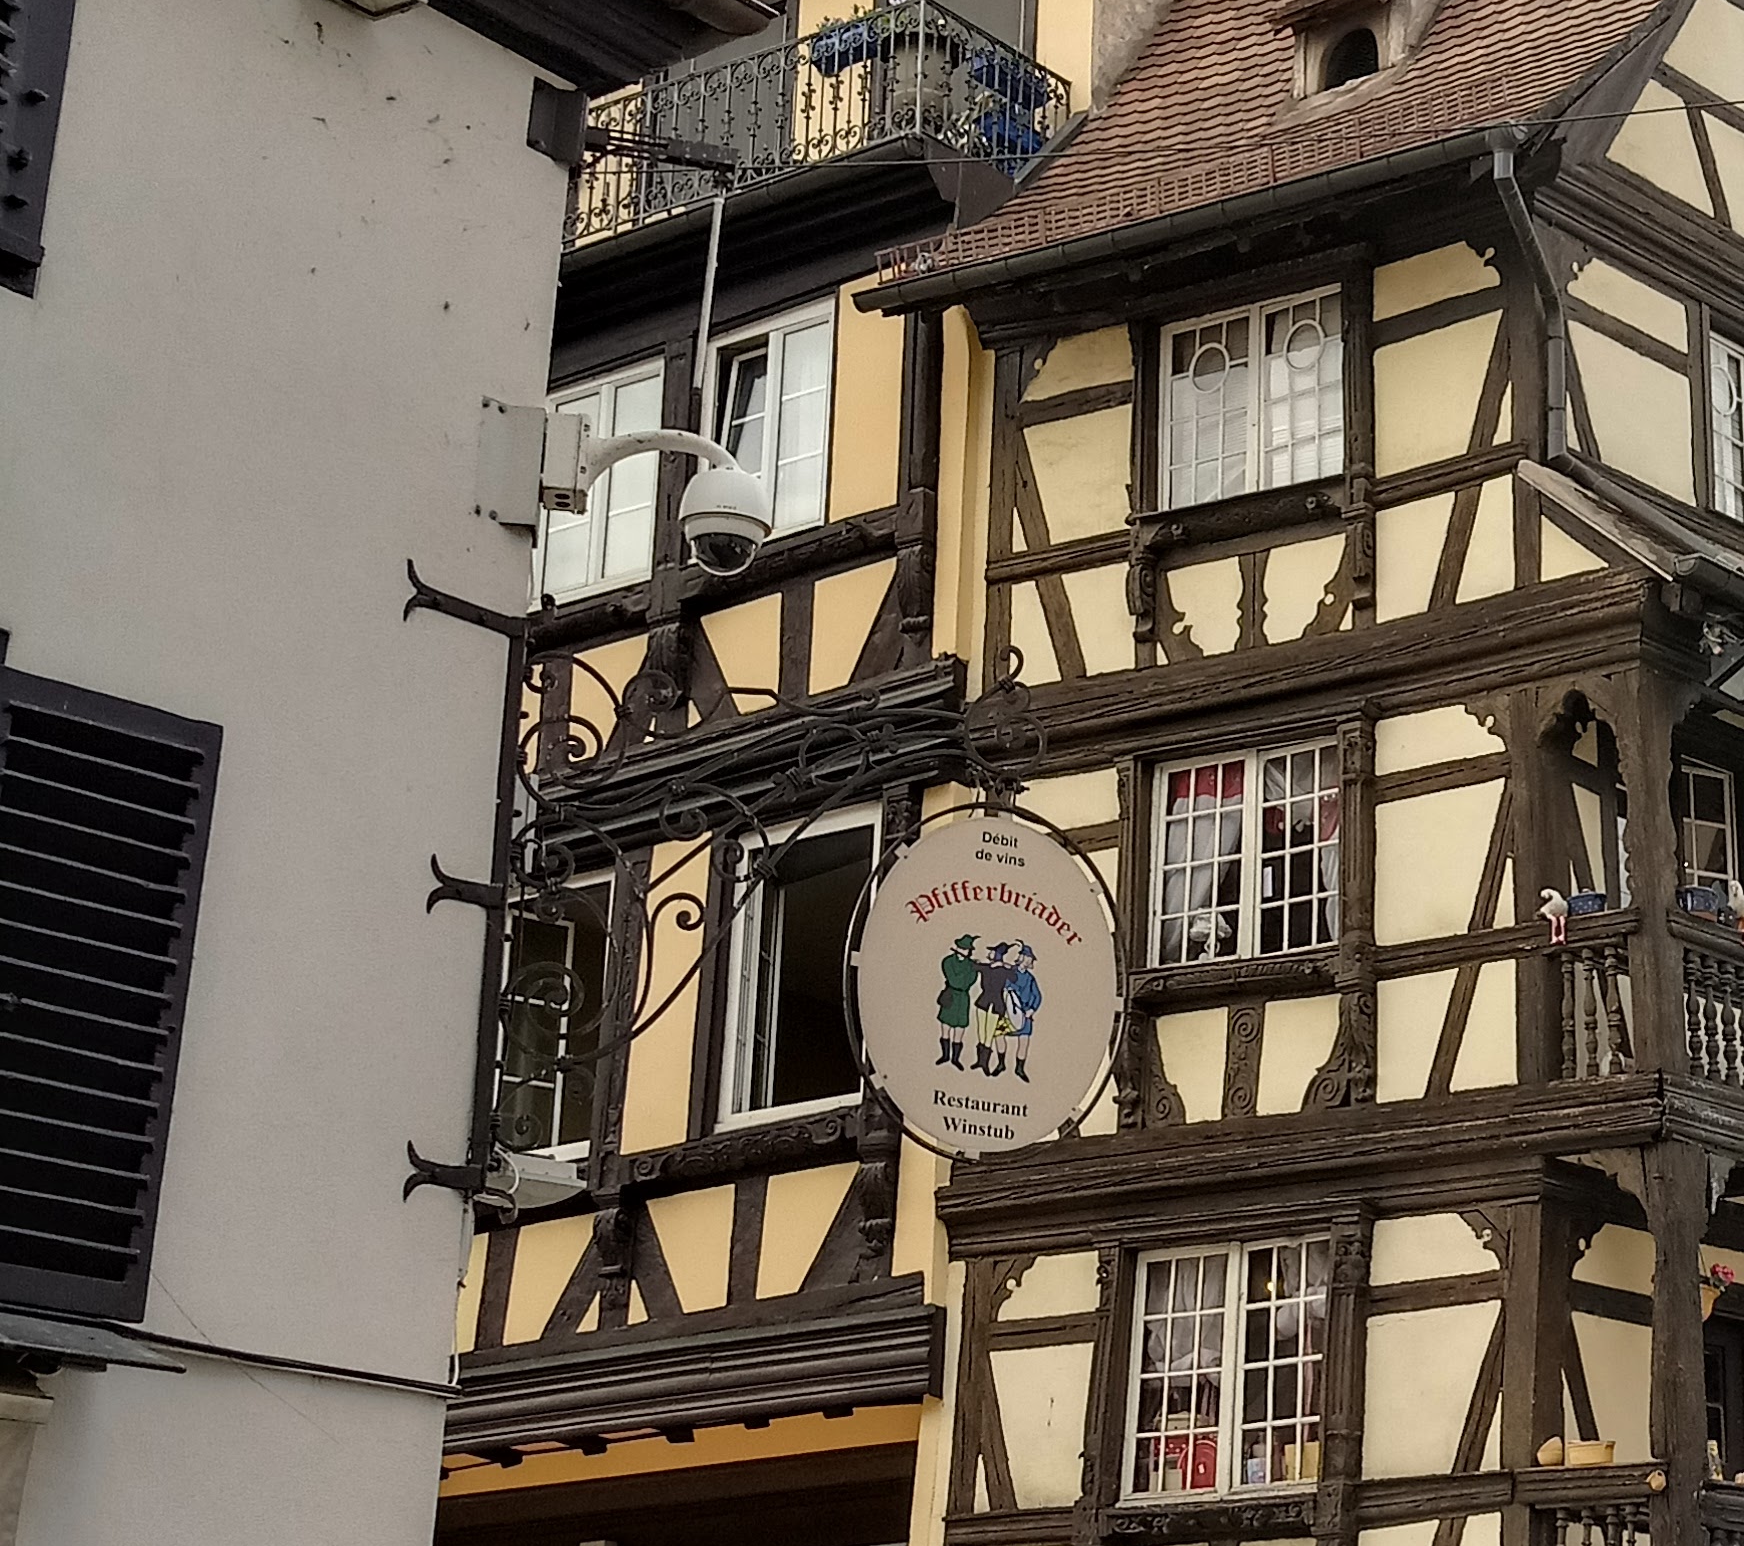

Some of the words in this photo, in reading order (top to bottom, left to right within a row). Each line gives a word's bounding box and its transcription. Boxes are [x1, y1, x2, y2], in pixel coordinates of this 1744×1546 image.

[982, 831, 1018, 848] Débit
[975, 848, 993, 861] de
[996, 853, 1026, 867] vins
[905, 879, 1082, 946] Pfifferbriader
[933, 1089, 1029, 1118] Restaurant
[943, 1115, 1015, 1141] Winstub
